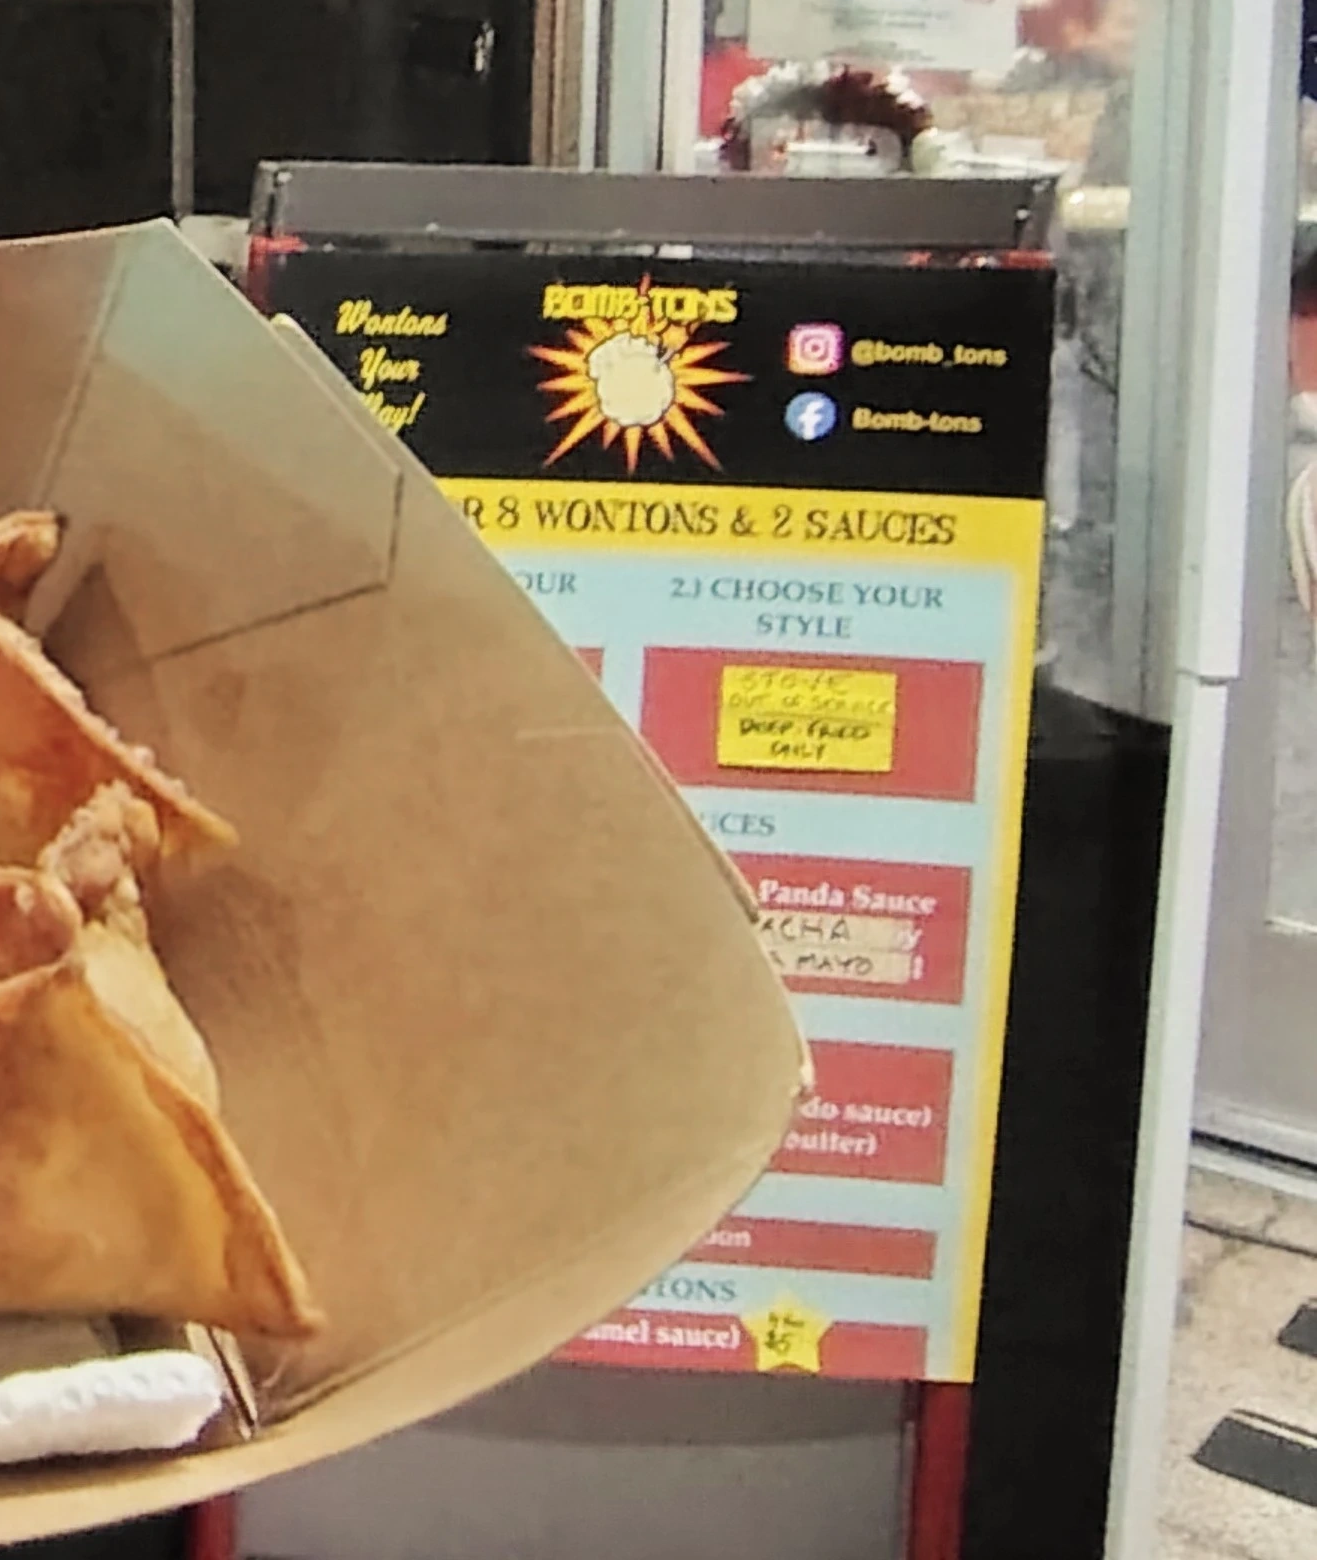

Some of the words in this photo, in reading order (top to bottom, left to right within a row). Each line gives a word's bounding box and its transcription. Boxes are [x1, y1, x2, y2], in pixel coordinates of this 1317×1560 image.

[335, 298, 449, 336] Wontons
[542, 283, 739, 323] BOMB-TONS
[359, 344, 421, 391] Your
[852, 406, 983, 434] Bomb-tons
[496, 496, 521, 530] 8
[533, 498, 719, 536] WONTONS
[729, 505, 758, 538] &
[772, 504, 793, 539] 2
[803, 506, 958, 546] SAUCES
[516, 570, 577, 595] OUR
[710, 576, 844, 606] CHOOSE
[852, 582, 944, 609] YOUR
[757, 611, 852, 639] STYLE
[758, 878, 845, 908] Panda
[852, 885, 937, 915] Sauce
[583, 1318, 651, 1344] amel
[655, 1324, 741, 1349] sauce)
